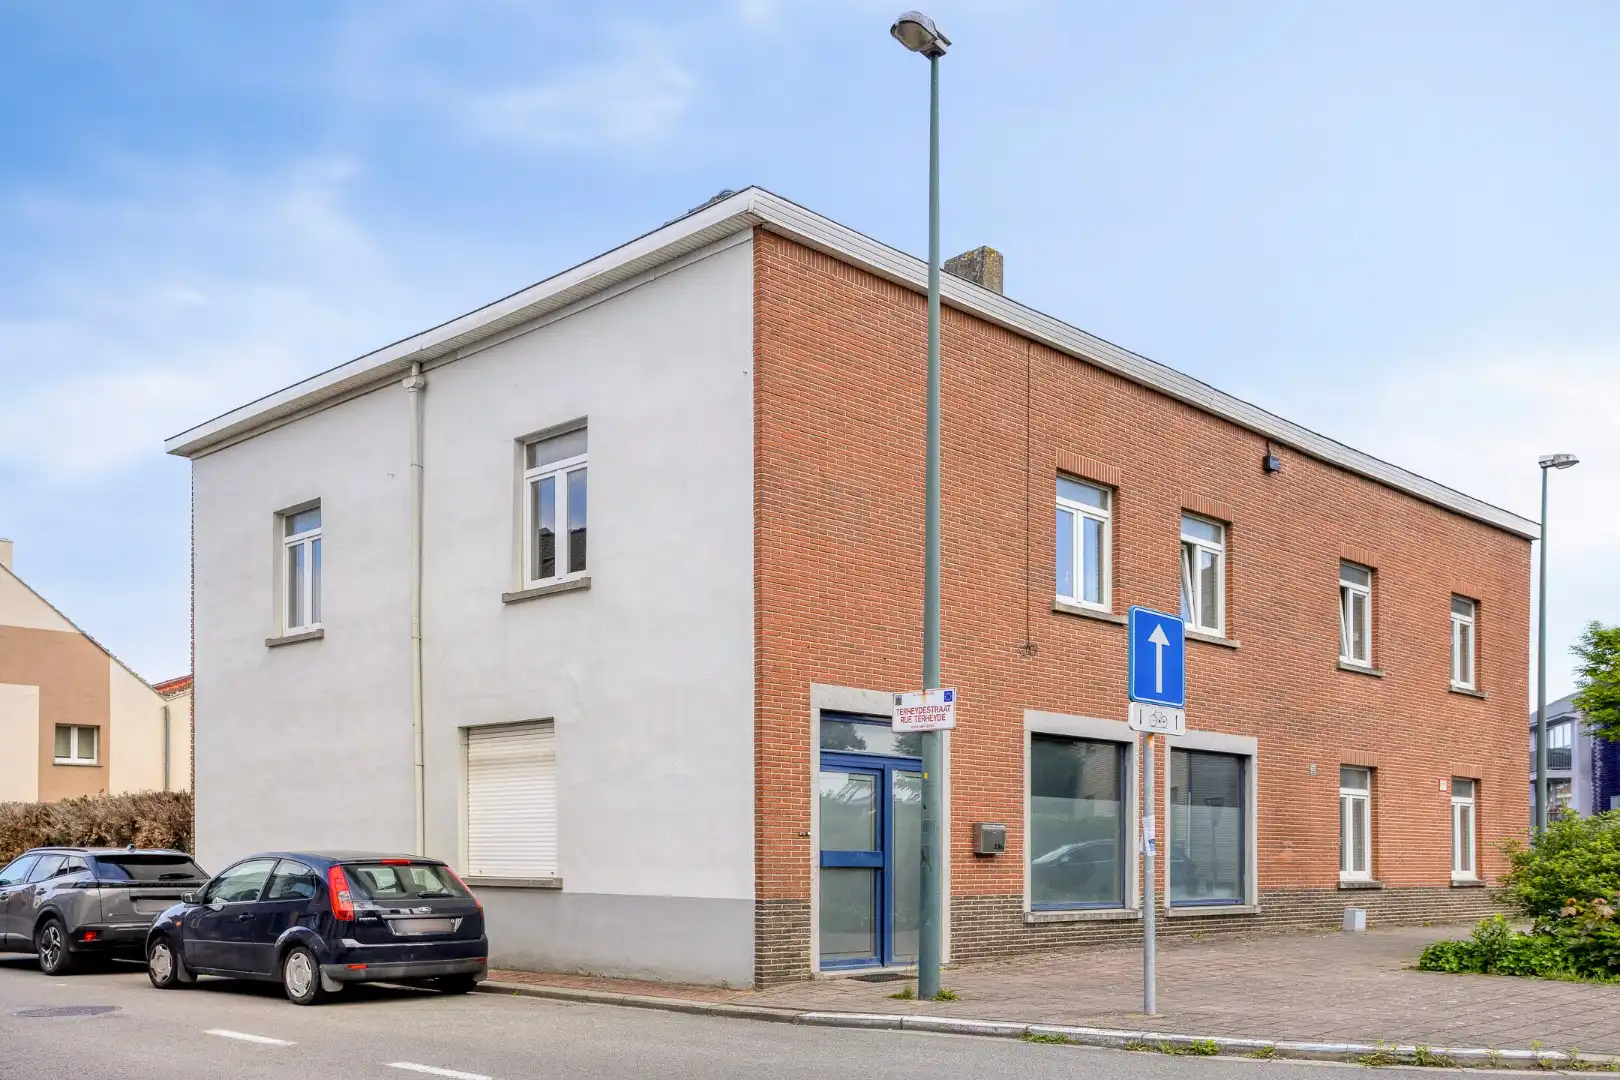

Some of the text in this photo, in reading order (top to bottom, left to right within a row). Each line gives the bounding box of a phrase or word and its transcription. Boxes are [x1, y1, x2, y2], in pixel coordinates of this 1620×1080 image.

[896, 705, 951, 716] TERHEYDESTRAAT
[900, 714, 946, 724] RUE TERHEYDE
